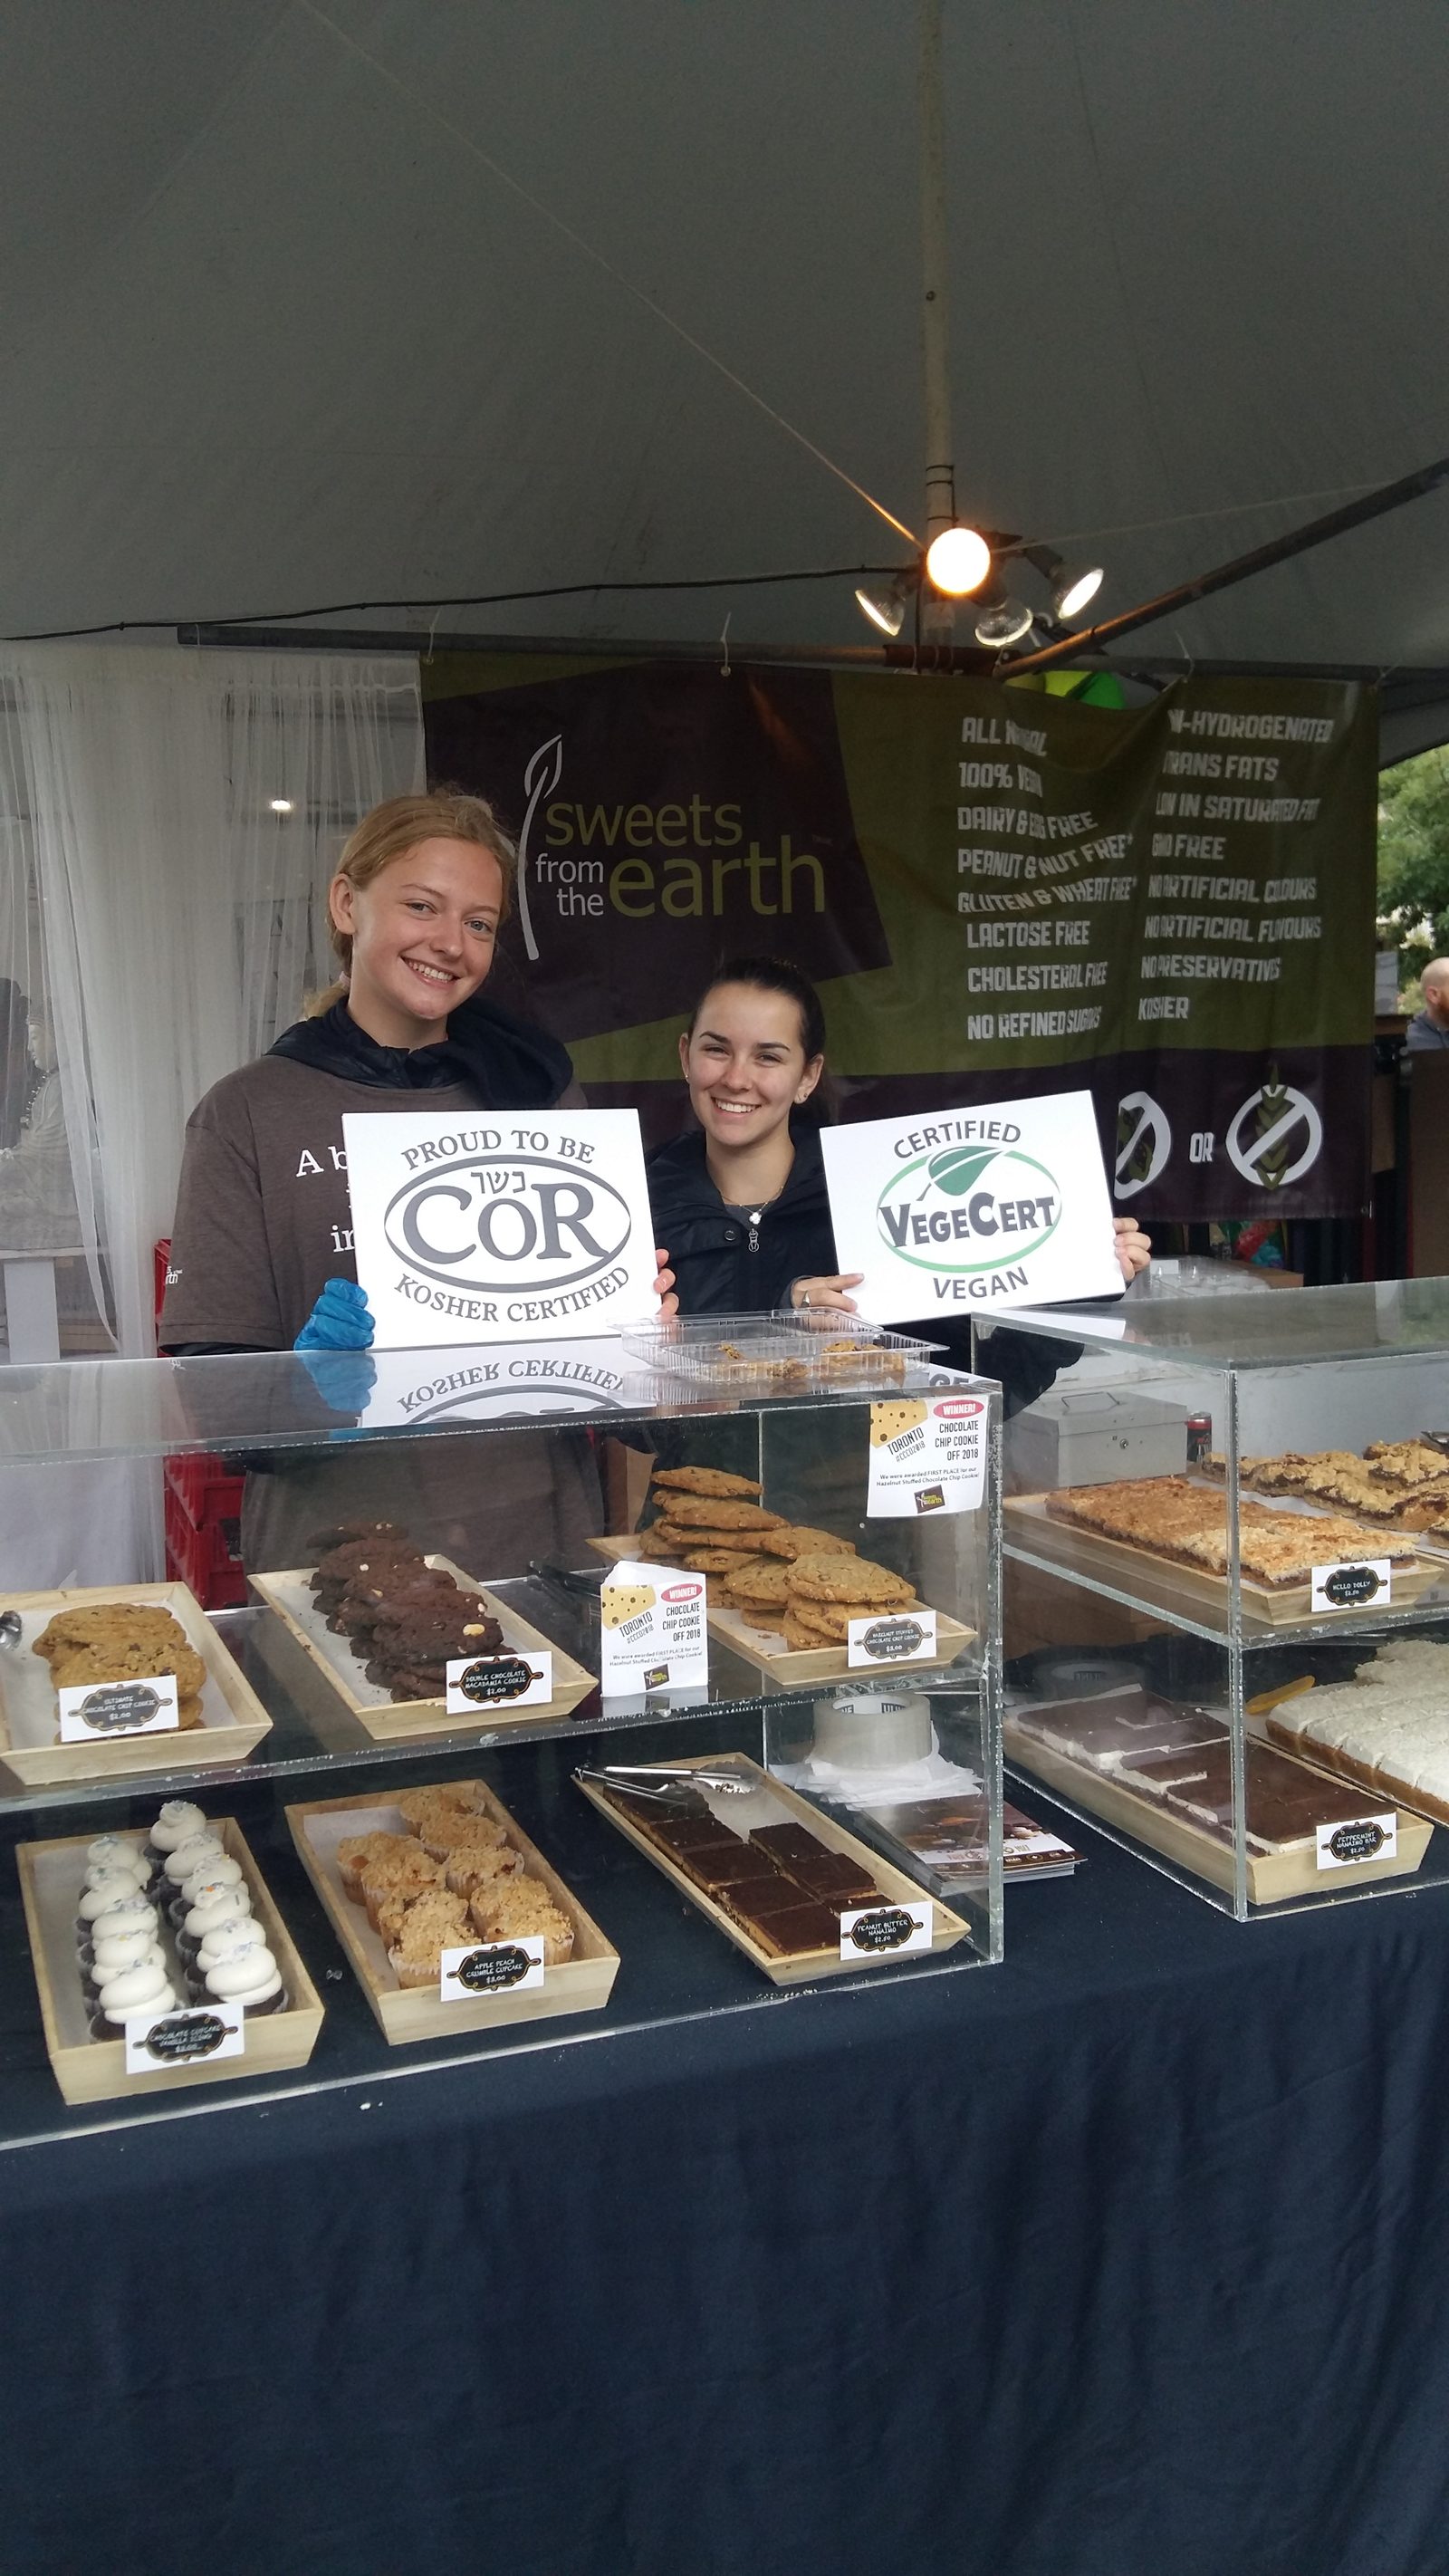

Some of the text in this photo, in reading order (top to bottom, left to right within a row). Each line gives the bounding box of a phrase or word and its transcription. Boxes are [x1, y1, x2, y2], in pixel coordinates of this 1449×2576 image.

[962, 716, 1001, 745] ALL
[958, 762, 1012, 788] 100%
[1224, 755, 1280, 782] FATS
[545, 794, 743, 847] sweets
[1178, 793, 1201, 817] IN
[1204, 795, 1299, 822] SATURATED
[957, 807, 1016, 833] DAIRY
[1016, 810, 1028, 835] &
[1047, 812, 1099, 840] FREE
[1174, 834, 1226, 860] FREE
[535, 852, 604, 883] from
[609, 835, 825, 918] earth
[958, 849, 1024, 878] PEANUT
[1024, 855, 1037, 879] &
[1038, 850, 1080, 877] NUT
[557, 887, 604, 916] the
[958, 892, 1036, 913] GLUTEN
[1033, 889, 1051, 905] &
[1051, 877, 1109, 903] WHEAT
[1162, 875, 1260, 902] ARTIFICIAL
[967, 920, 1090, 948] LACTOSE FREE
[1159, 915, 1253, 942] ARTIFICIAL
[968, 961, 1108, 992] CHOLESTEROL FREE
[1141, 956, 1157, 978] NO
[1137, 996, 1189, 1020] KOSHER
[967, 1014, 994, 1040] NO
[998, 1011, 1067, 1038] REFINED
[401, 1129, 595, 1170] PROUD TO BE
[894, 1120, 1022, 1159] CERTIFIED
[1190, 1132, 1214, 1163] OR
[296, 1149, 324, 1177] A
[394, 1266, 629, 1322] KOSHER CERTIFIED
[933, 1266, 1029, 1300] VEGAN
[943, 1403, 976, 1416] WINNER!
[939, 1420, 979, 1434] CHOCOLATE
[887, 1427, 925, 1456] TORONTO
[935, 1436, 979, 1448] CHIP COOKIE
[946, 1448, 979, 1461] OFF 2018
[922, 1475, 948, 1484] Chocolate
[669, 1586, 697, 1600] WINNER!
[1332, 1581, 1370, 1591] HELLO DOLLY
[662, 1616, 701, 1630] CHIP COOKIE
[666, 1602, 700, 1617] CHOCOLATE
[619, 1611, 653, 1638] TORONTO
[673, 1629, 701, 1642] OFF 2018
[465, 1669, 526, 1683] DOUBLE CHOCOLATE
[465, 1676, 526, 1689] MACADAMIA COOKIE
[1338, 1831, 1376, 1843] PEPPERMINT
[857, 1918, 908, 1933] PEANUT BUTTER
[868, 1927, 897, 1937] NANAIMO
[465, 1963, 523, 1978] CRUMBLE CUPCAKE
[474, 1957, 515, 1970] APPLE PEACH
